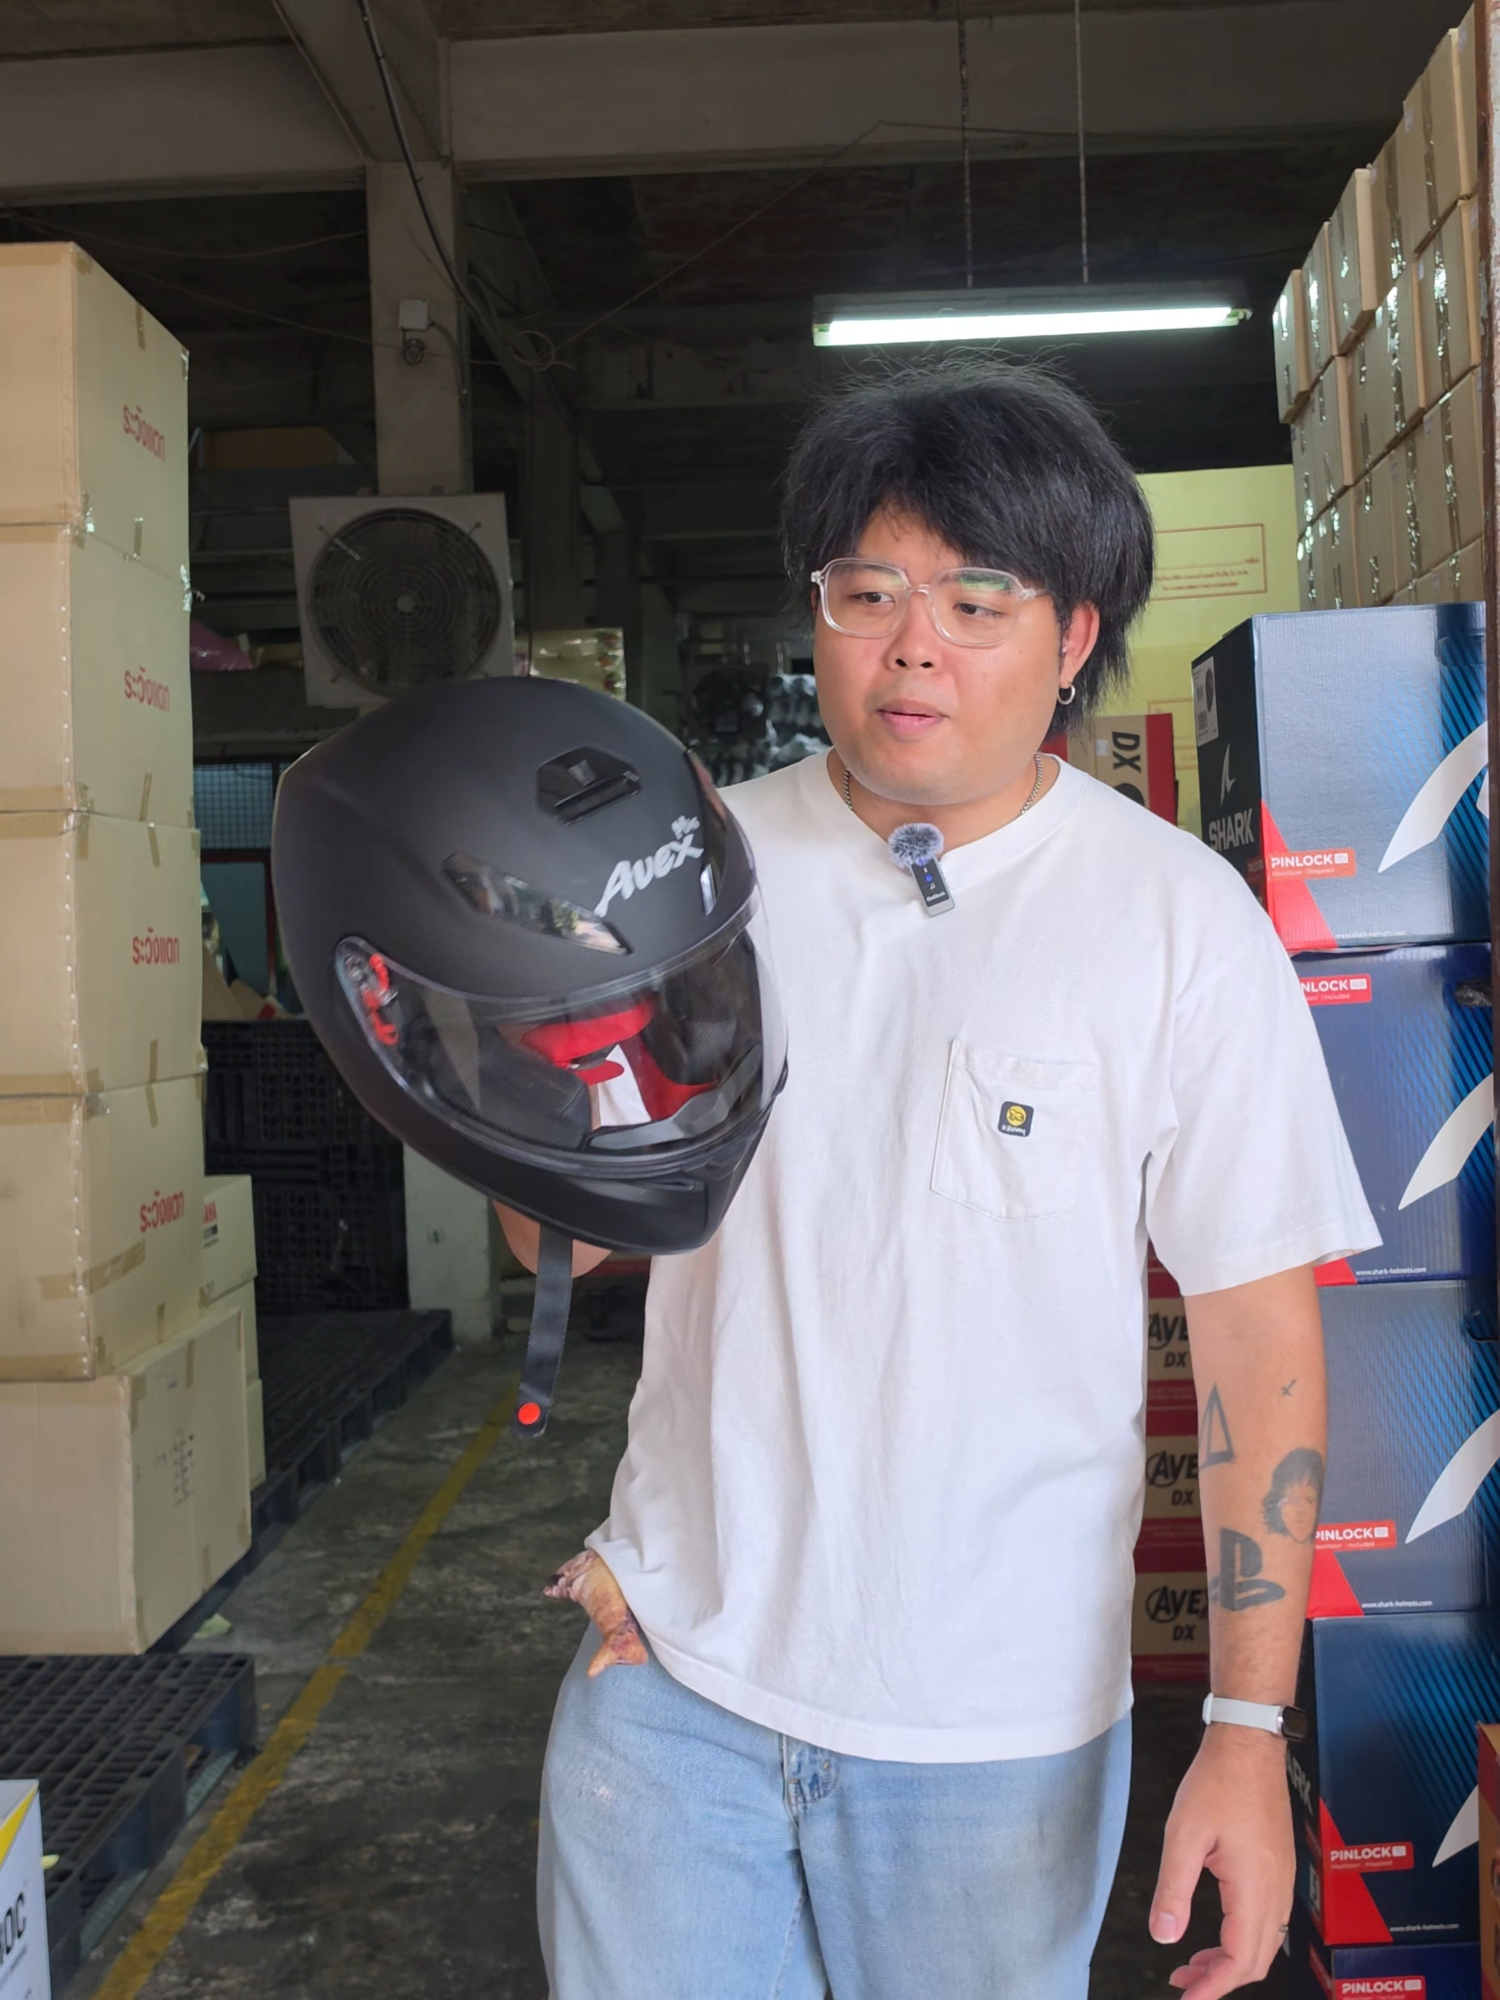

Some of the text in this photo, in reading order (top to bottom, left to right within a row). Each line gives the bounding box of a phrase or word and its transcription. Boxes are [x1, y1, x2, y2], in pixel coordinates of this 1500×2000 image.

[124, 665, 170, 713] ระวังแตก
[1111, 731, 1141, 773] DX
[1208, 808, 1255, 851] SHARK
[1271, 853, 1333, 868] PINLOCK
[132, 926, 180, 965] ระวังแตก
[1300, 979, 1349, 992] NLOCK
[140, 1190, 184, 1233] ระวังแตก
[1163, 1351, 1188, 1368] DX
[1145, 1451, 1198, 1488] AVE
[1171, 1490, 1194, 1506] DX
[1173, 1625, 1196, 1641] DX
[1330, 1847, 1391, 1861] PINLOCK
[1342, 1980, 1403, 1994] PINLOCK
